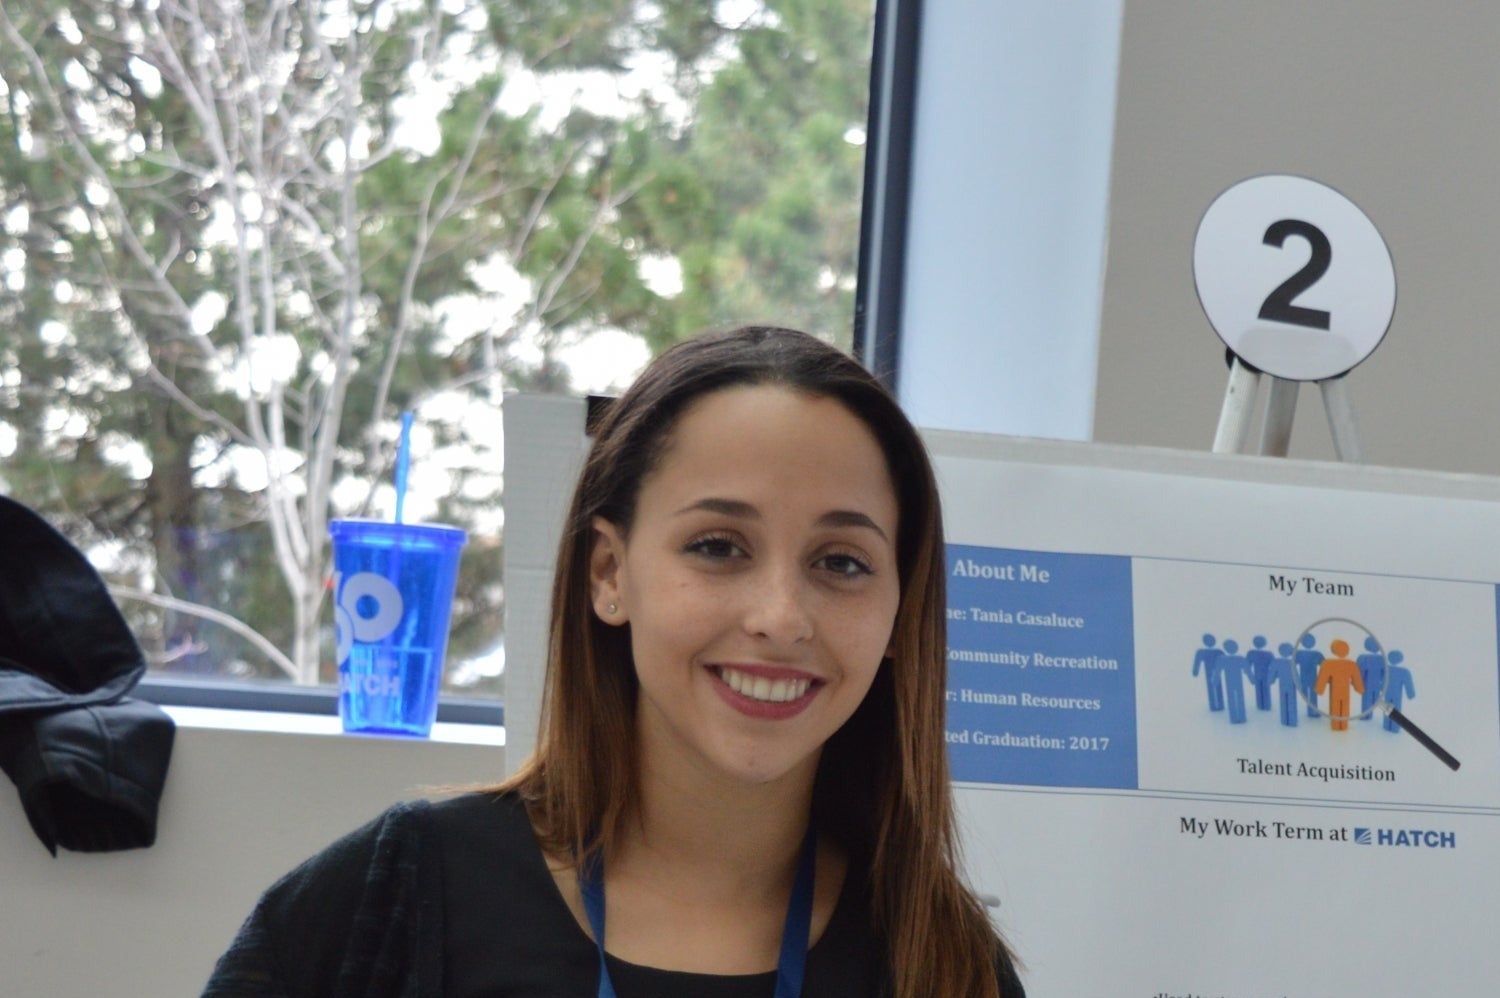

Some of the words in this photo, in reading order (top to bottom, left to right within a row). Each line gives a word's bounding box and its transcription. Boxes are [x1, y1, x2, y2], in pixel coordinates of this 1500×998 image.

[1256, 218, 1332, 331] 2
[952, 558, 1015, 581] About
[1019, 563, 1050, 583] Me
[1268, 574, 1297, 596] My
[1301, 576, 1354, 596] Team
[969, 606, 1013, 624] Tania
[1015, 610, 1084, 629] Casaluce
[946, 647, 1030, 669] ommunity
[1032, 652, 1118, 670] Recreation
[340, 671, 401, 696] ATCH
[960, 688, 1017, 706] Human
[1020, 692, 1101, 710] Resources
[972, 730, 1065, 750] Graduation:
[1068, 735, 1110, 751] 2017
[1236, 757, 1291, 776] Talent
[1296, 761, 1395, 783] Acquisition
[1179, 816, 1209, 839] My
[1213, 818, 1267, 838] Work
[1271, 821, 1323, 841] Term
[1328, 826, 1347, 842] at
[1377, 828, 1455, 849] HATCH
